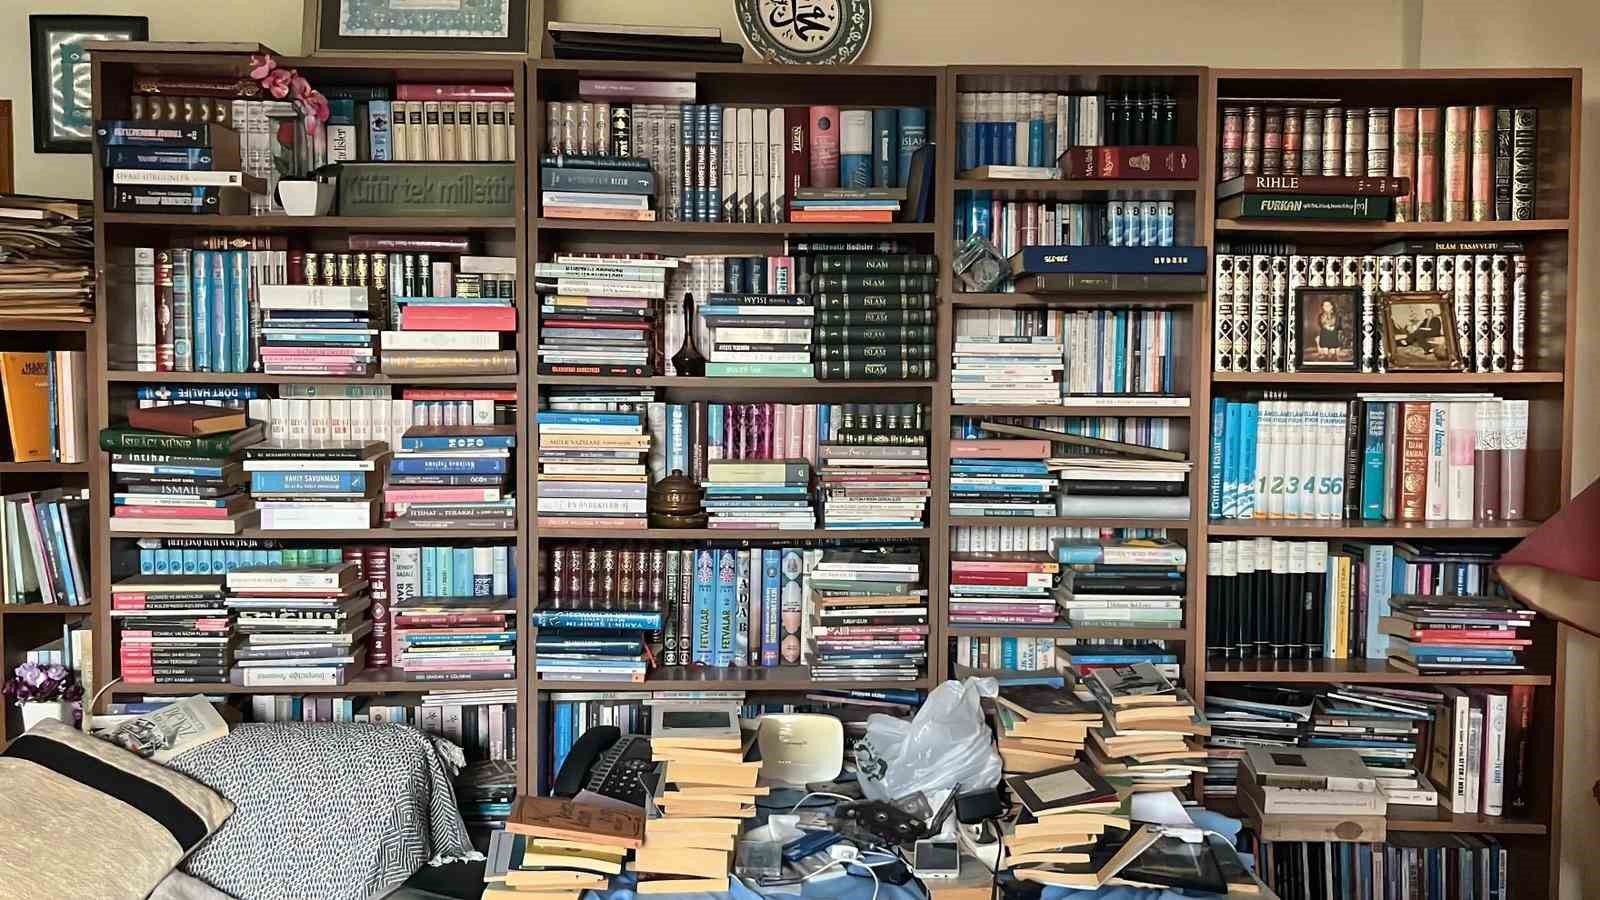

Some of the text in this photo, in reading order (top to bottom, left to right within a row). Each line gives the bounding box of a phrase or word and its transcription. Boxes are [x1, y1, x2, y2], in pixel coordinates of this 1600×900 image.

[1260, 200, 1302, 211] FURKAN
[1258, 476, 1267, 494] 1
[1271, 476, 1284, 494] 2
[1286, 476, 1300, 494] 3
[1303, 476, 1316, 494] 4
[1318, 476, 1331, 494] 5
[1330, 476, 1343, 494] 6
